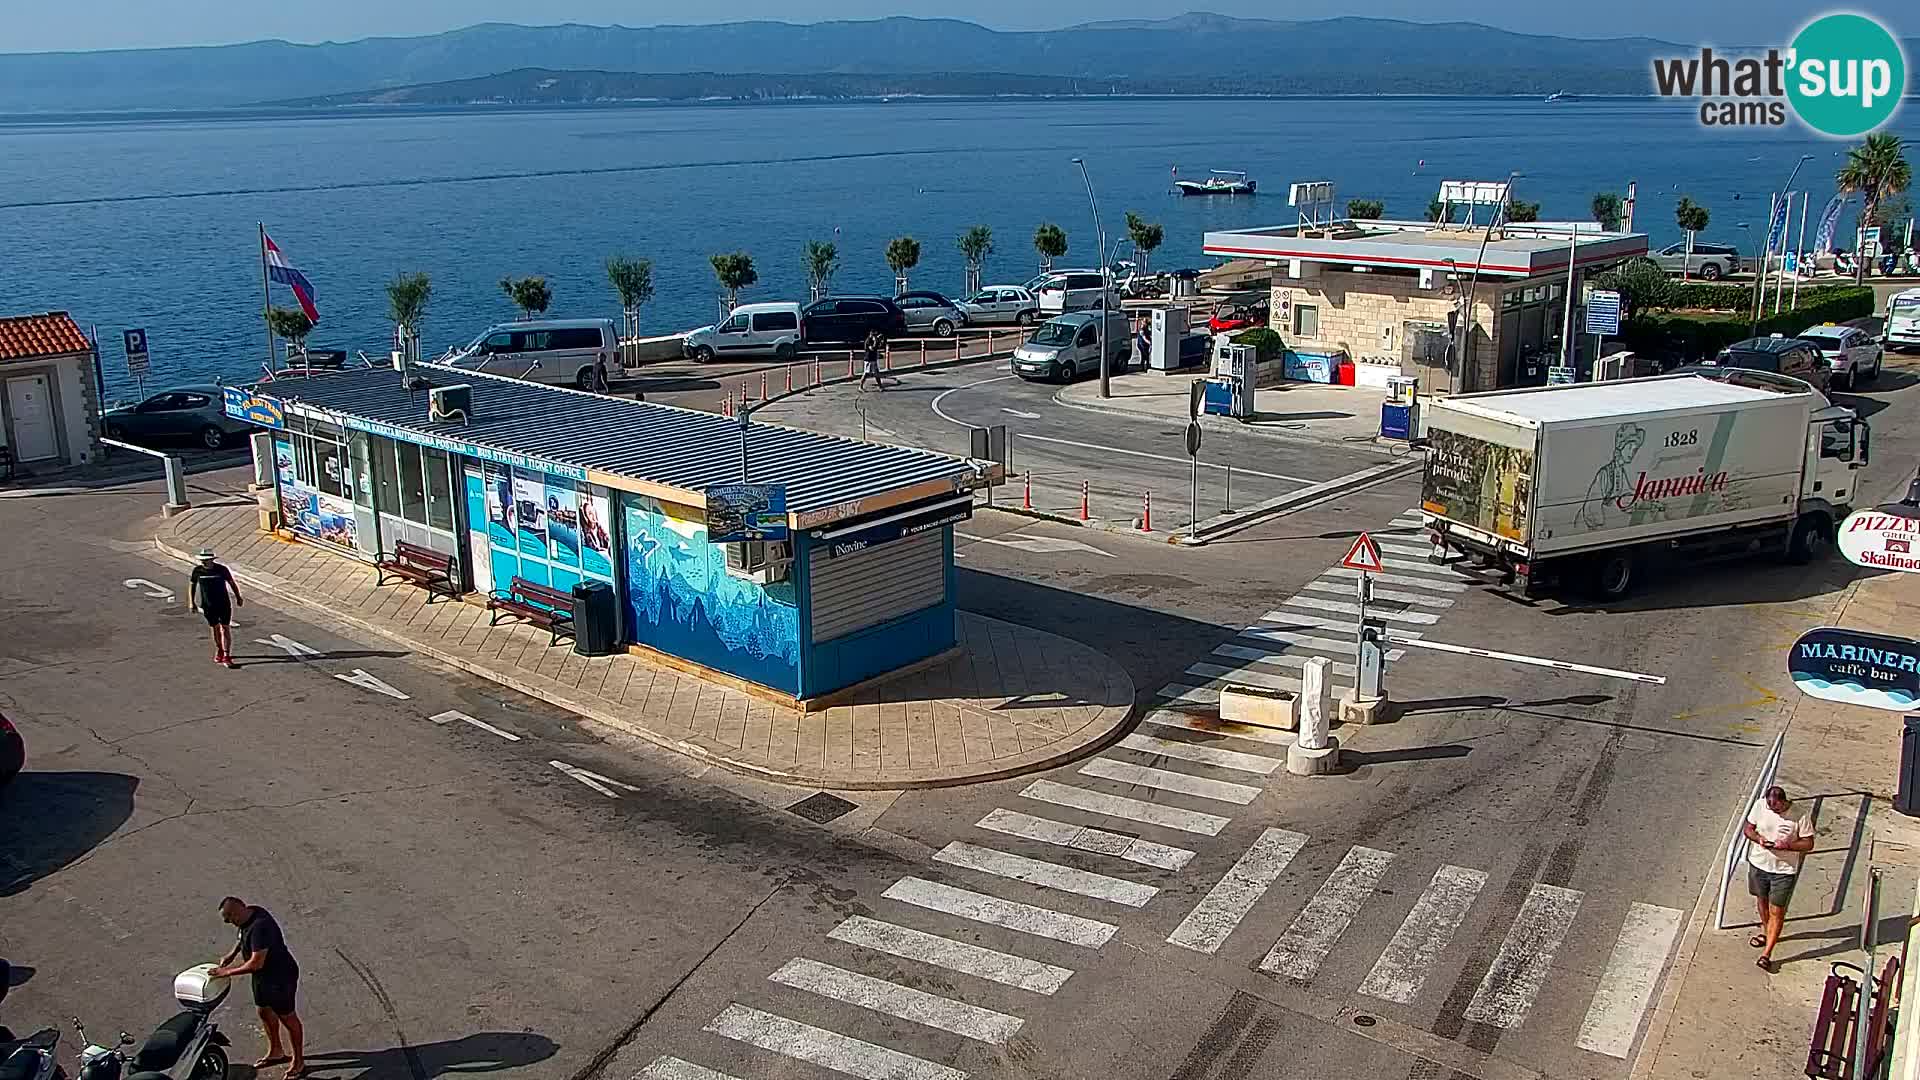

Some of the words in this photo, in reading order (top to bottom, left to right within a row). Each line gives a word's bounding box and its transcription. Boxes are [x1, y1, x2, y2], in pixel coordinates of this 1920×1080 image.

[1664, 429, 1698, 448] 1828
[478, 447, 492, 459] BUS
[493, 450, 526, 467] STATION
[528, 459, 553, 473] TICKET
[555, 464, 581, 479] OFFICE
[1616, 466, 1729, 510] Jamnica
[1829, 663, 1866, 677] caffe
[1870, 667, 1897, 681] bar
